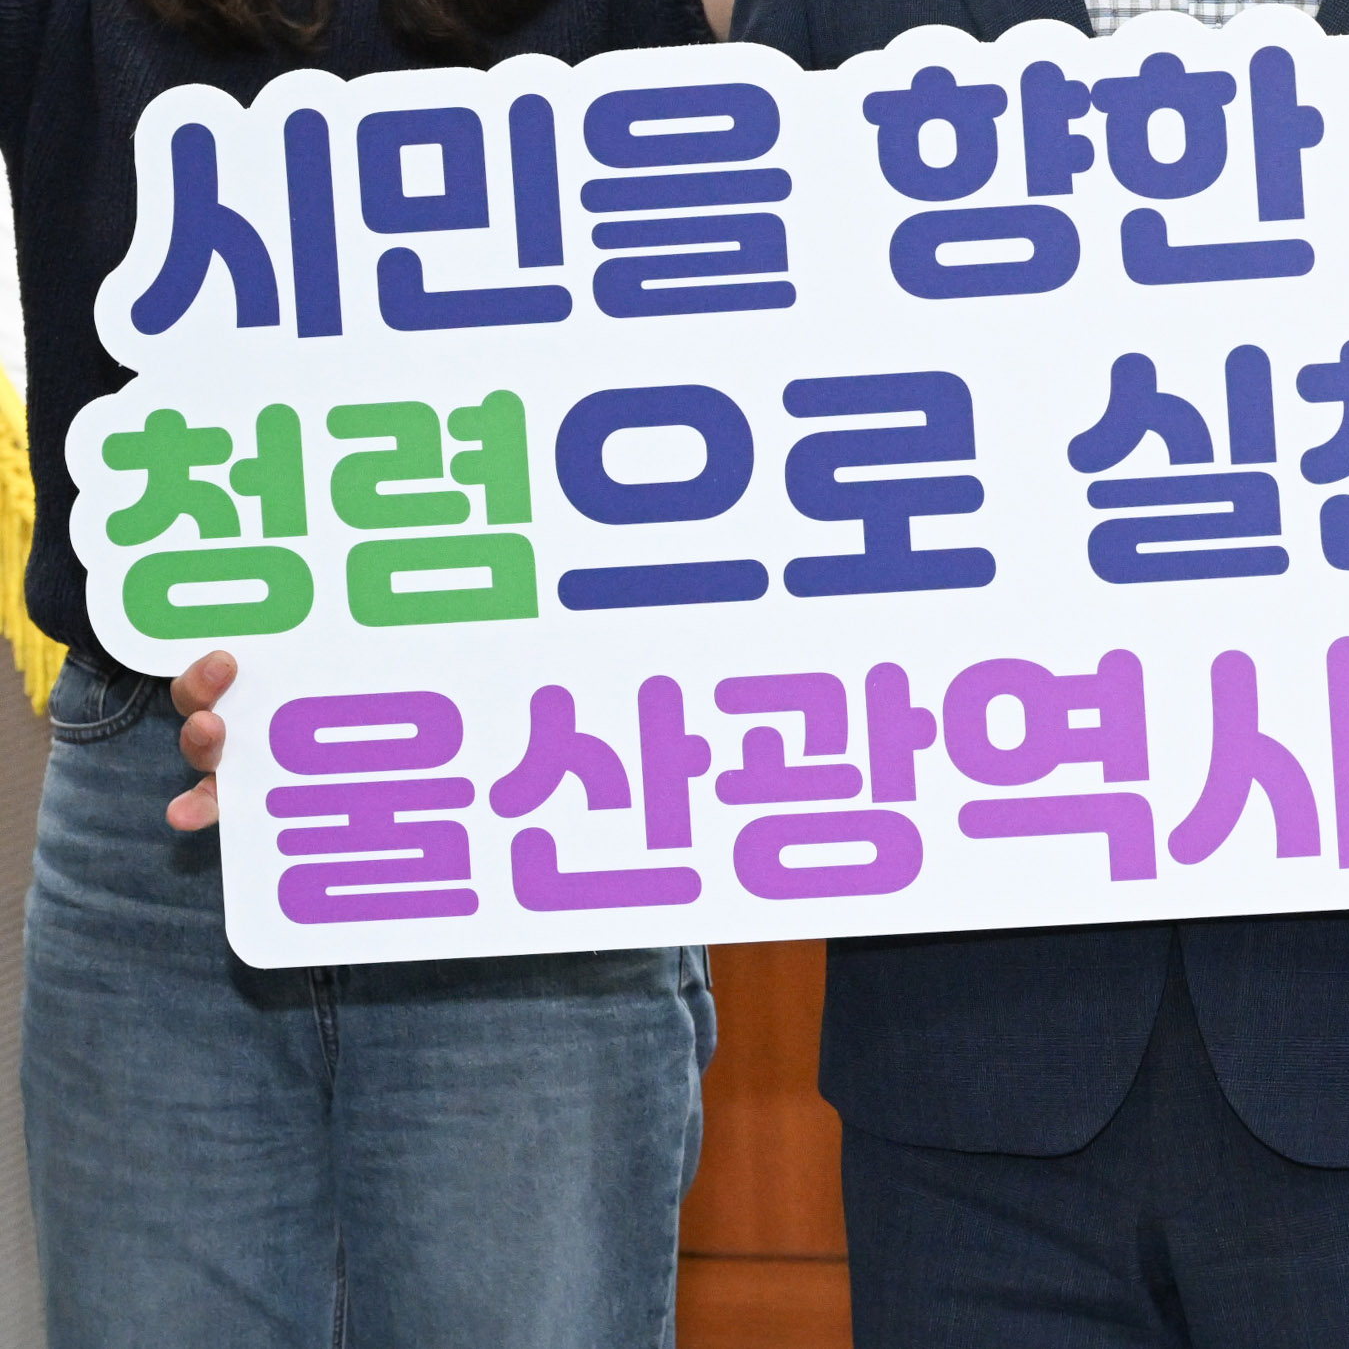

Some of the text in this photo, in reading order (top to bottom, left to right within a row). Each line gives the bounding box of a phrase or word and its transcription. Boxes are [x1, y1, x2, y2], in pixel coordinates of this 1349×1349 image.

[130, 82, 798, 340] 시민을
[861, 44, 1326, 301] 향한
[101, 370, 998, 641] 청렴으로
